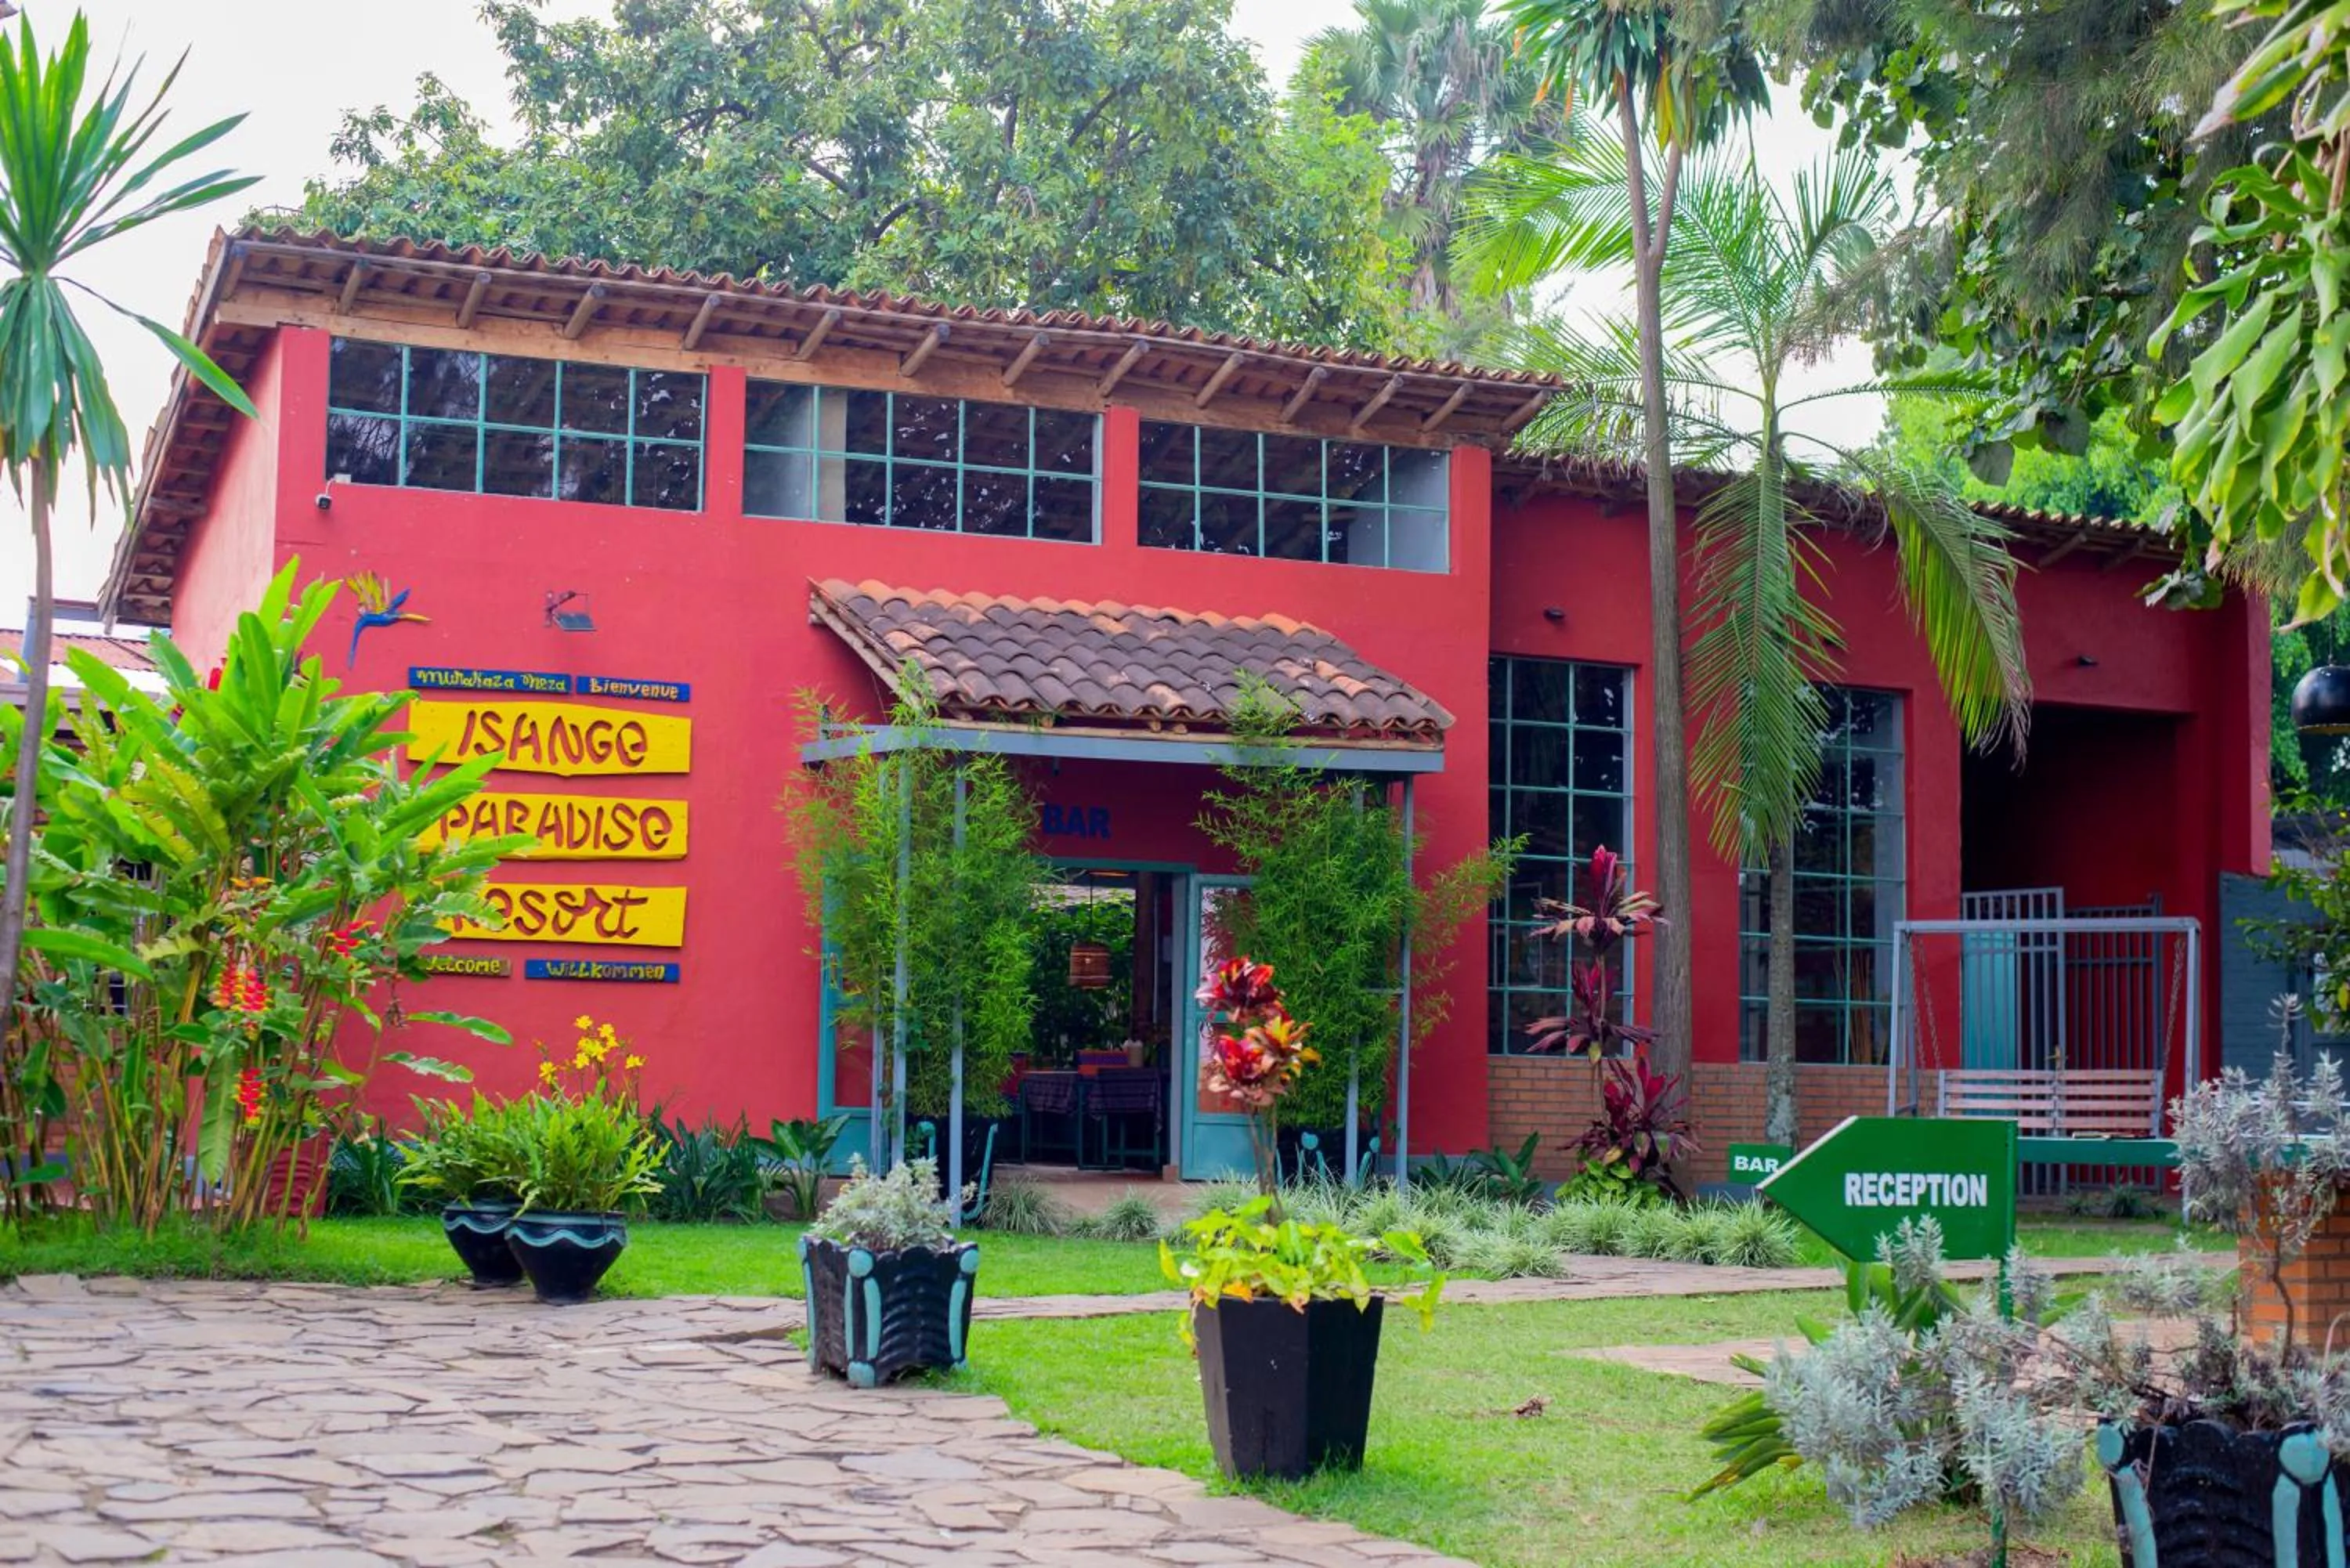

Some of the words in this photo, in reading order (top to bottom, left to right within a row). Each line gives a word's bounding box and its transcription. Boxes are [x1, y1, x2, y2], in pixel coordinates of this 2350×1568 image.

[590, 677, 678, 699] Bienvenue
[1043, 801, 1111, 840] BAR
[1734, 1155, 1779, 1172] BAR
[1845, 1173, 1987, 1207] RECEPTION
